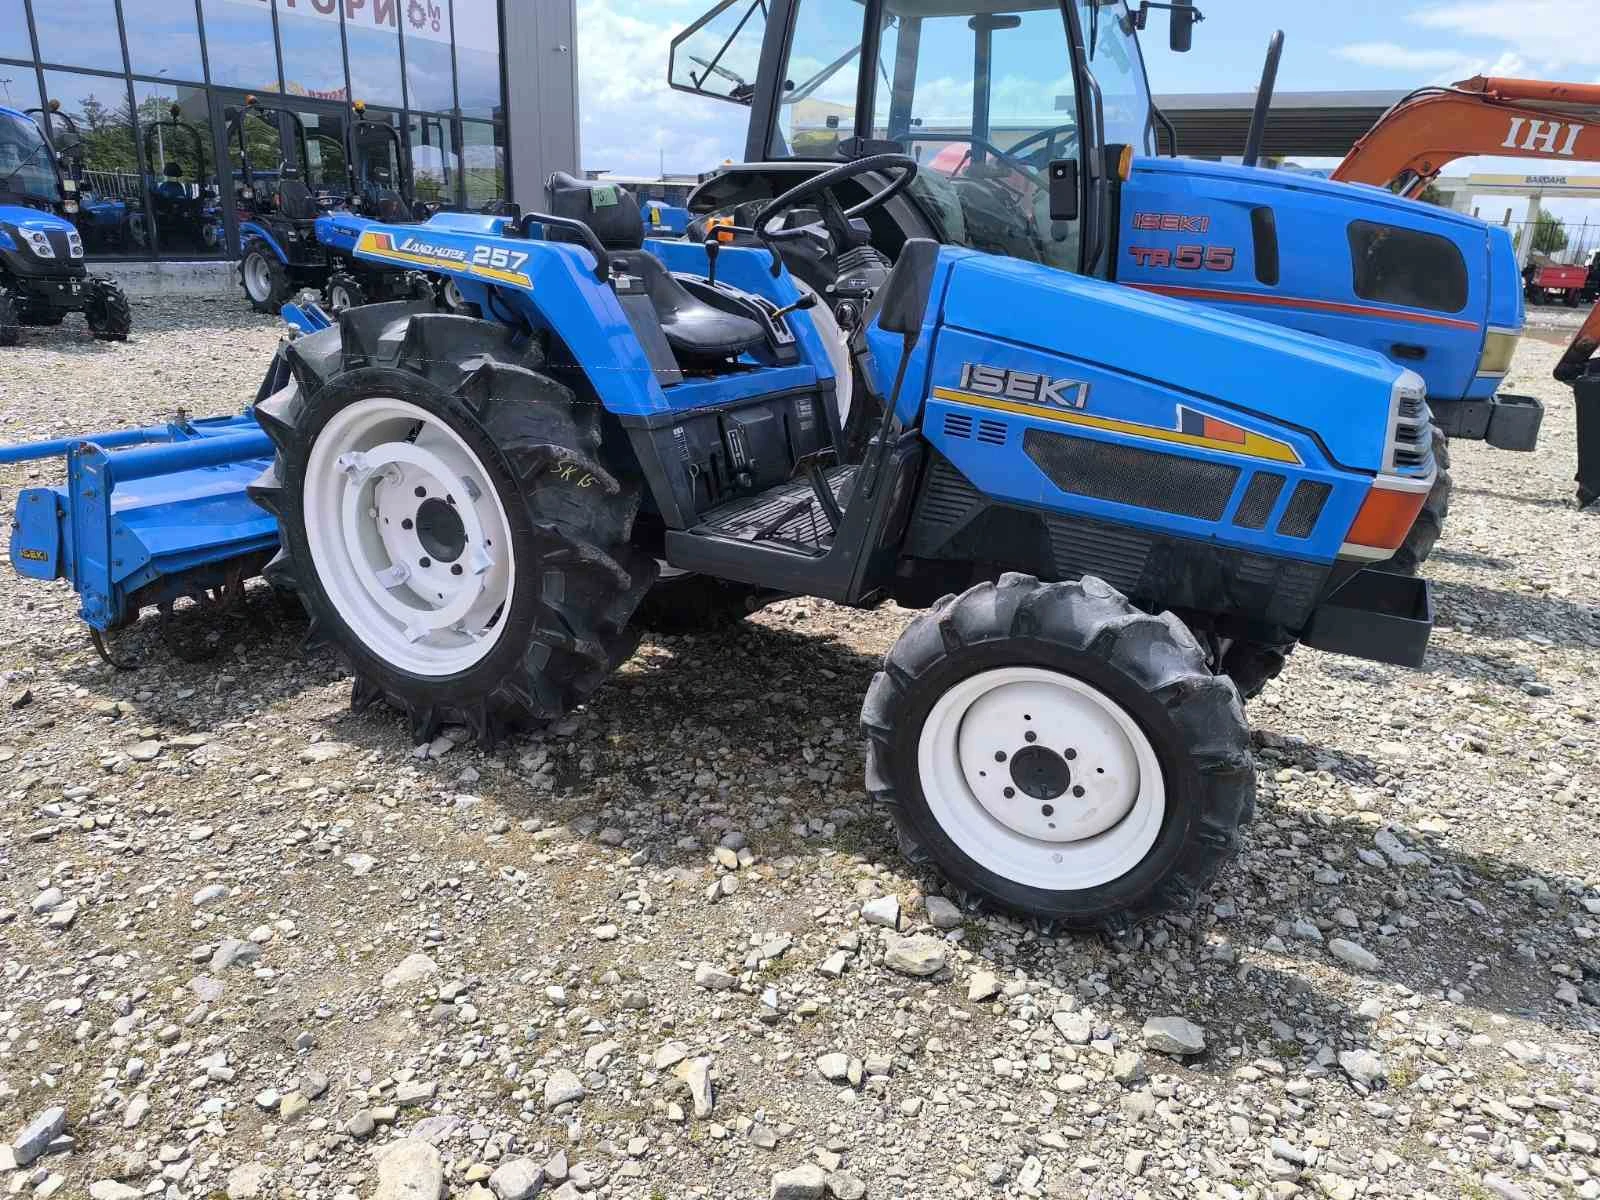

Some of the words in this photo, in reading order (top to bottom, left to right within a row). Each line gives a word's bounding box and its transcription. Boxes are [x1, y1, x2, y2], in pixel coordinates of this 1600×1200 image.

[1501, 117, 1584, 155] IHI
[1134, 212, 1210, 233] ISEKI
[473, 245, 528, 270] 257
[960, 362, 1089, 409] ISEKI
